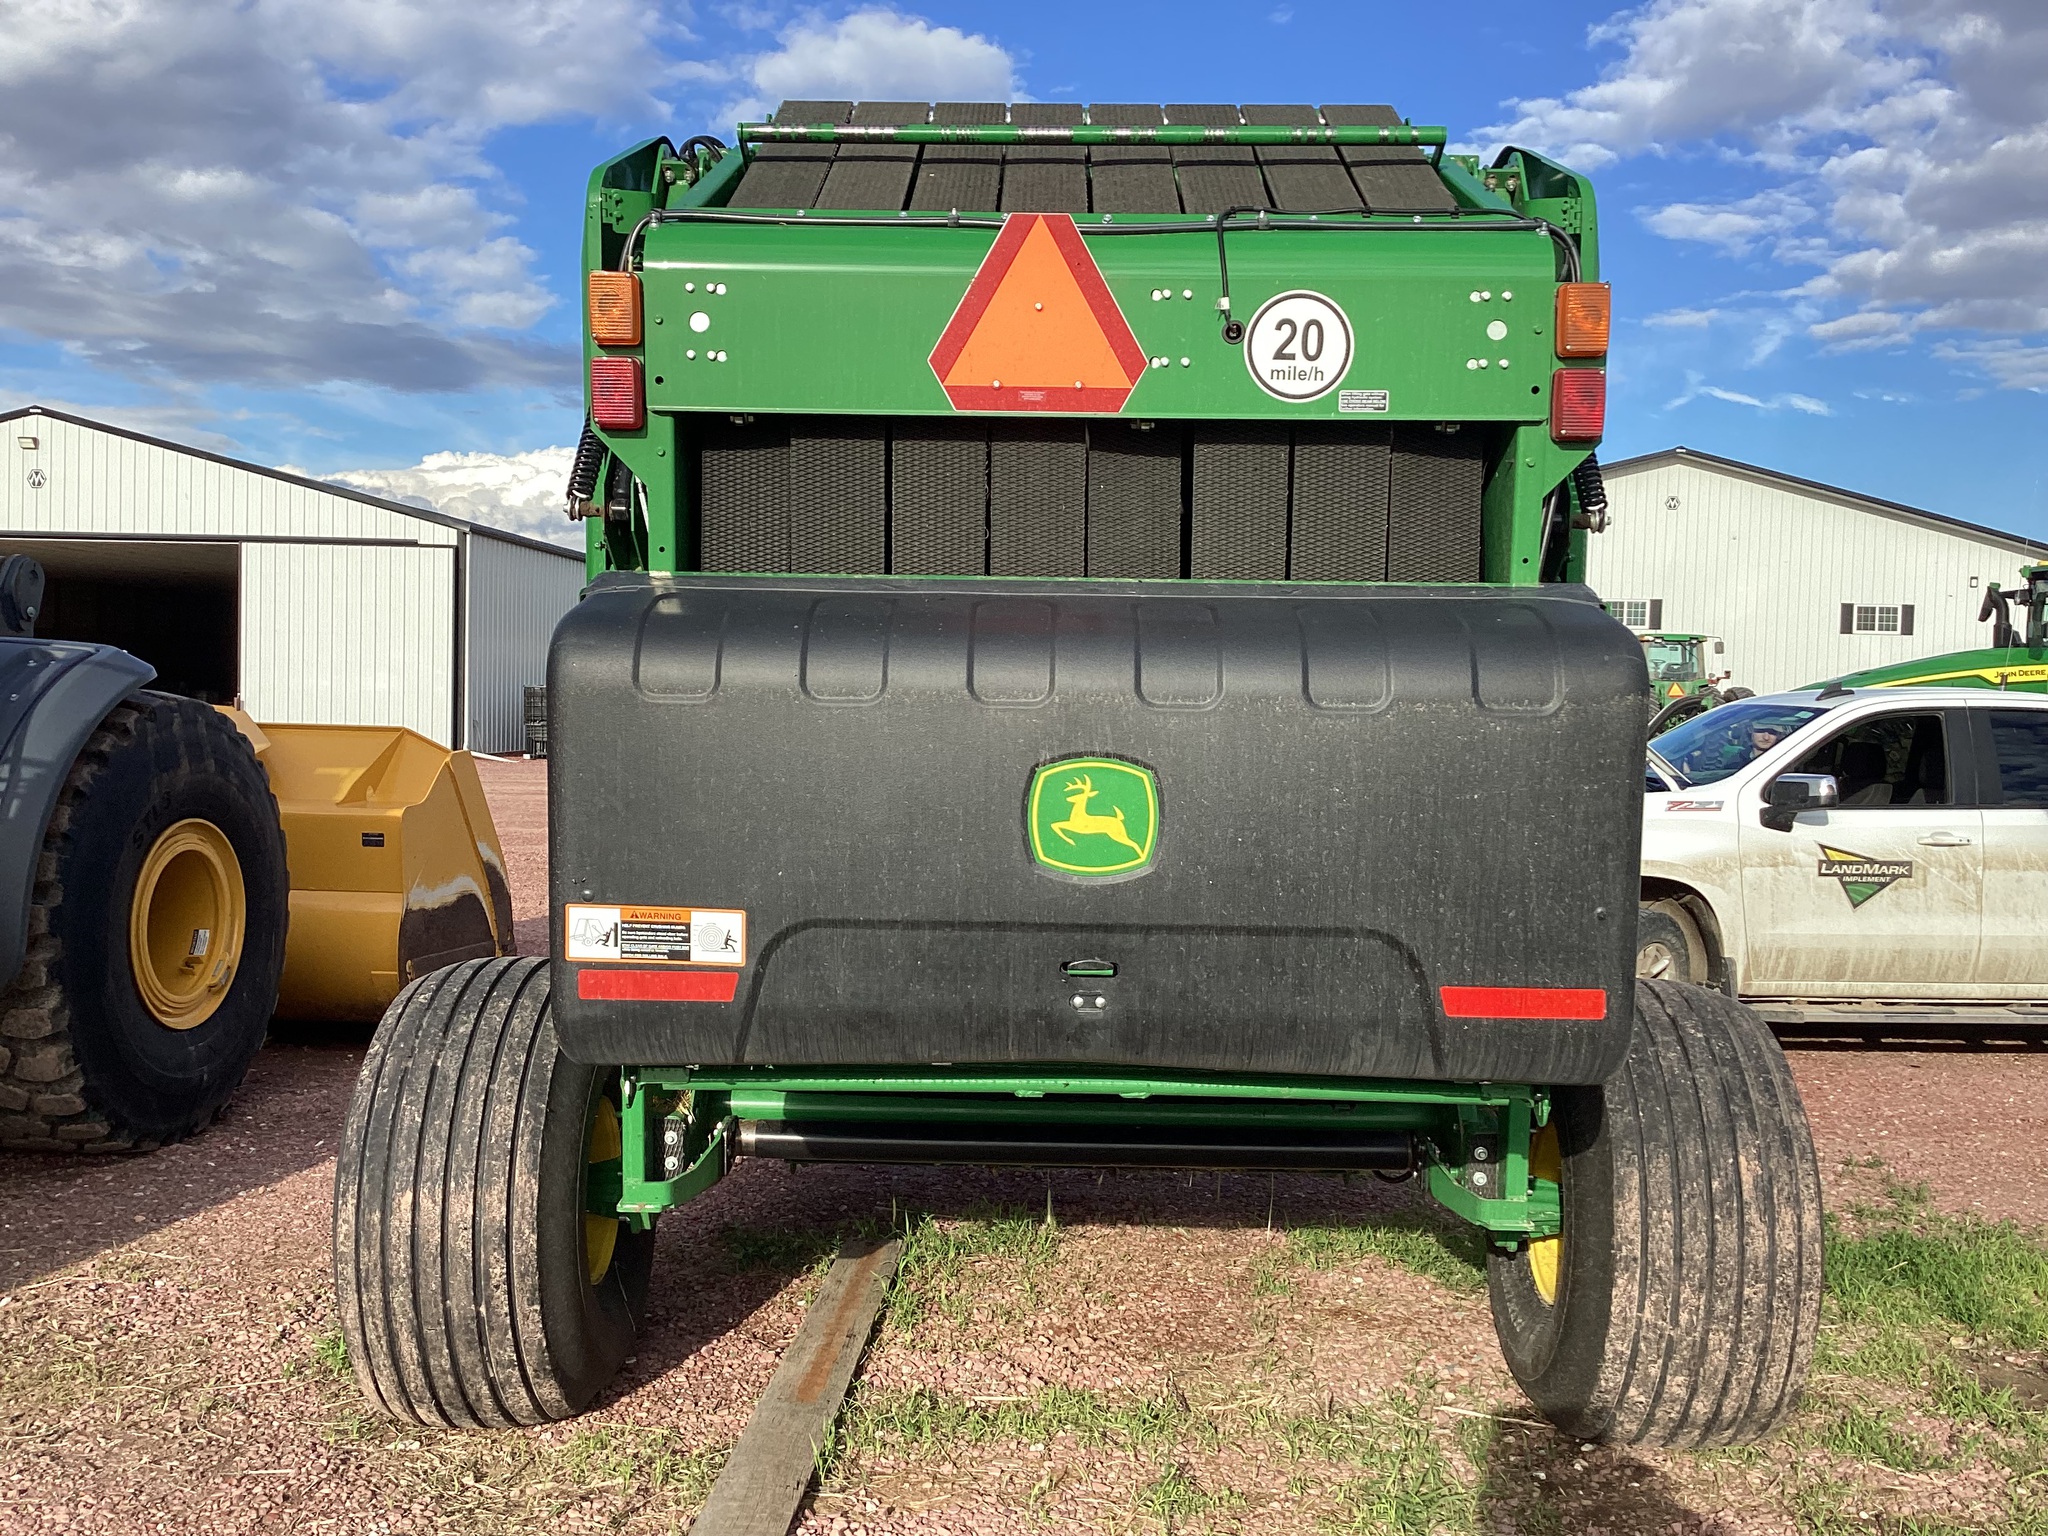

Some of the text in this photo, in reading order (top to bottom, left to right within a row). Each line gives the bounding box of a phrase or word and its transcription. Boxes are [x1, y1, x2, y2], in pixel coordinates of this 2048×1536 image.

[1272, 317, 1325, 362] 20
[1270, 365, 1325, 382] mile/h
[2018, 669, 2047, 677] DEERE
[639, 911, 682, 921] WARNING
